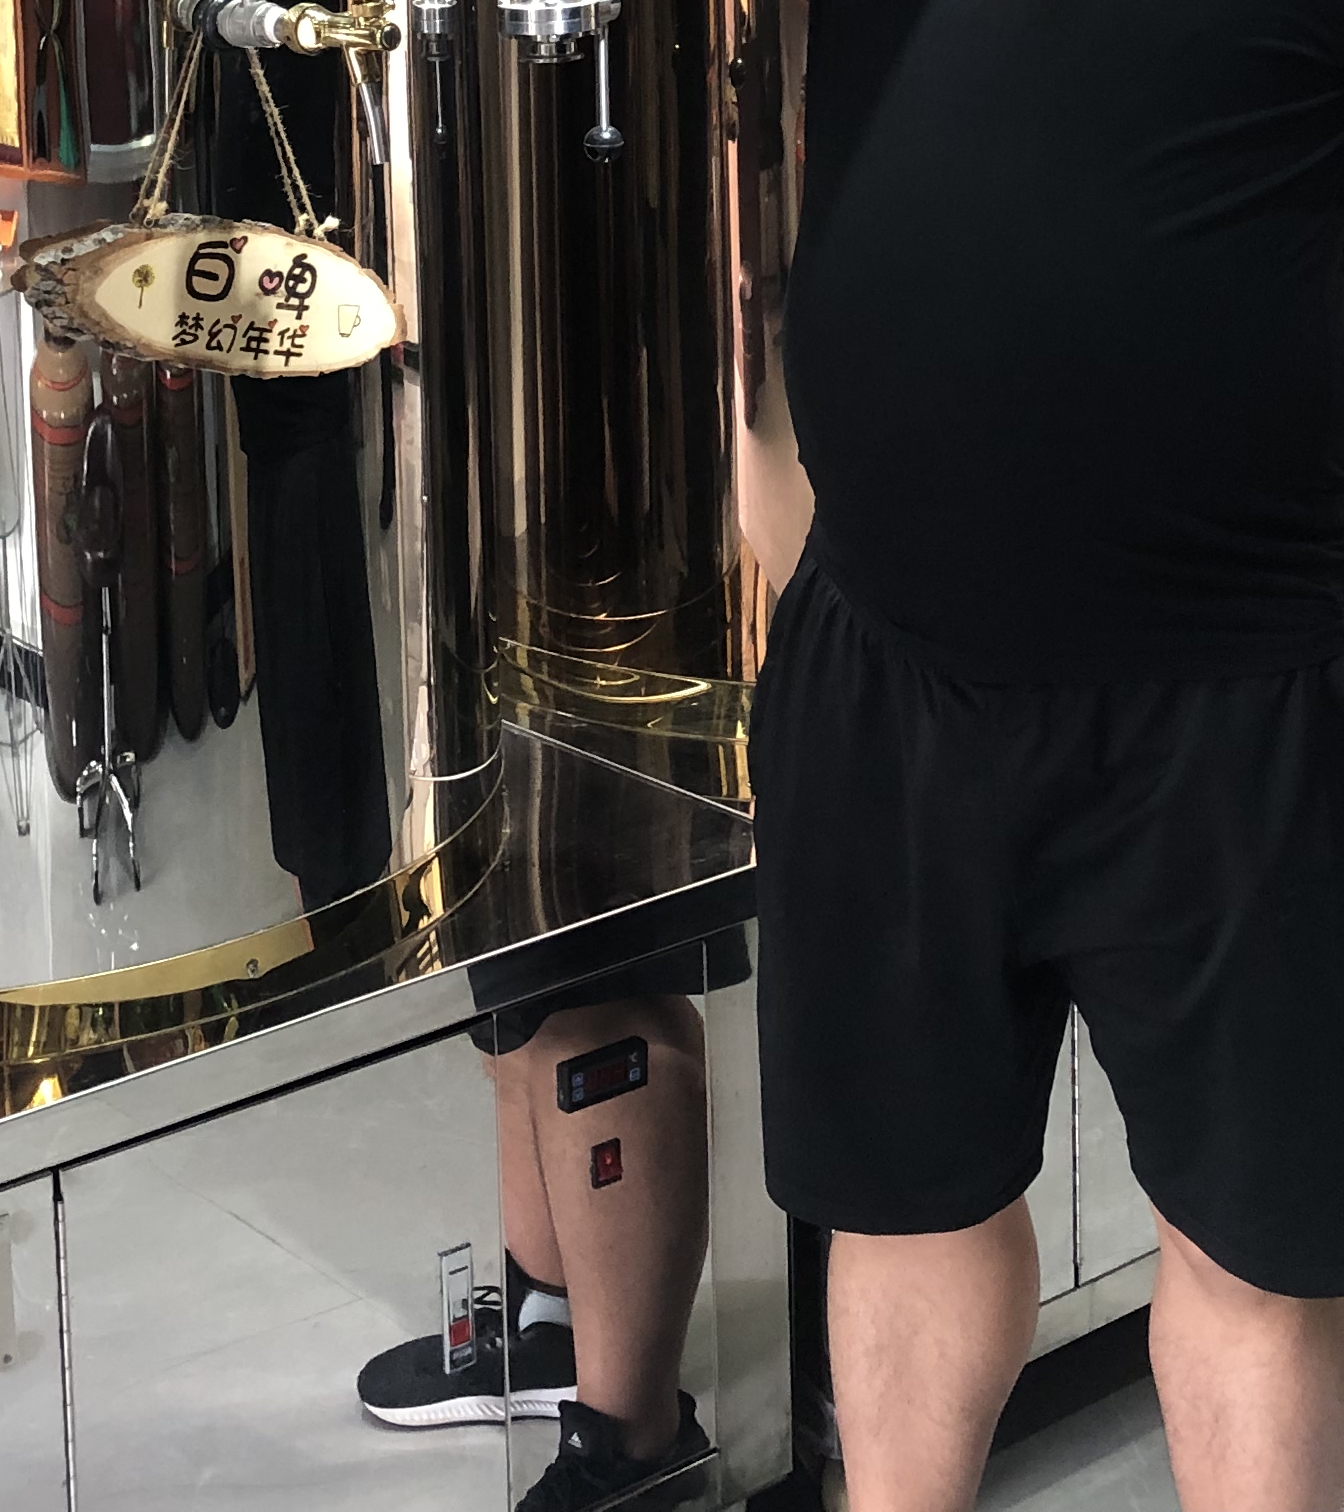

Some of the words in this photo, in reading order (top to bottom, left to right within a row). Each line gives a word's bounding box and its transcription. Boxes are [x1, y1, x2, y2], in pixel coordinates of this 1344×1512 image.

[185, 238, 318, 321] 白啤
[171, 311, 308, 367] 梦幻年华
